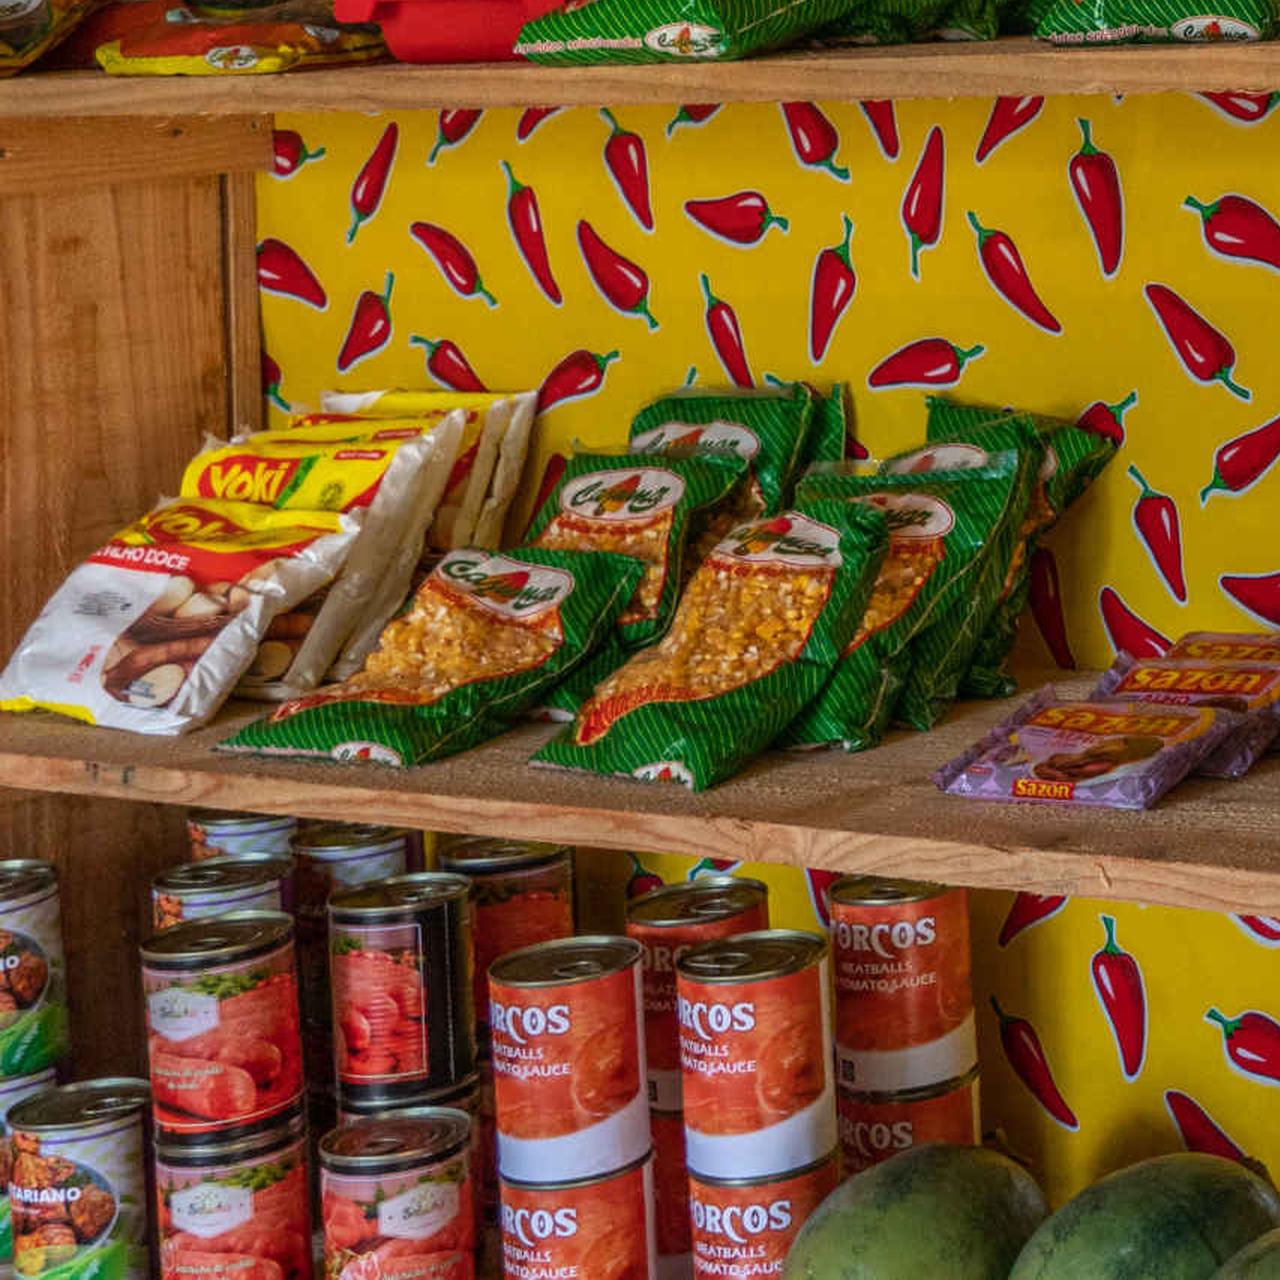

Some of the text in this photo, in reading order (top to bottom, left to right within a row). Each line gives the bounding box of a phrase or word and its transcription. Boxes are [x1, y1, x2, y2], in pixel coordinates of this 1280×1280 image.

[144, 548, 191, 571] DOCE
[490, 1001, 572, 1045] RCOS
[679, 998, 756, 1041] RCOS
[842, 1120, 913, 1157] RCOS
[8, 1186, 82, 1205] TARIANO
[501, 1203, 578, 1247] RCOS
